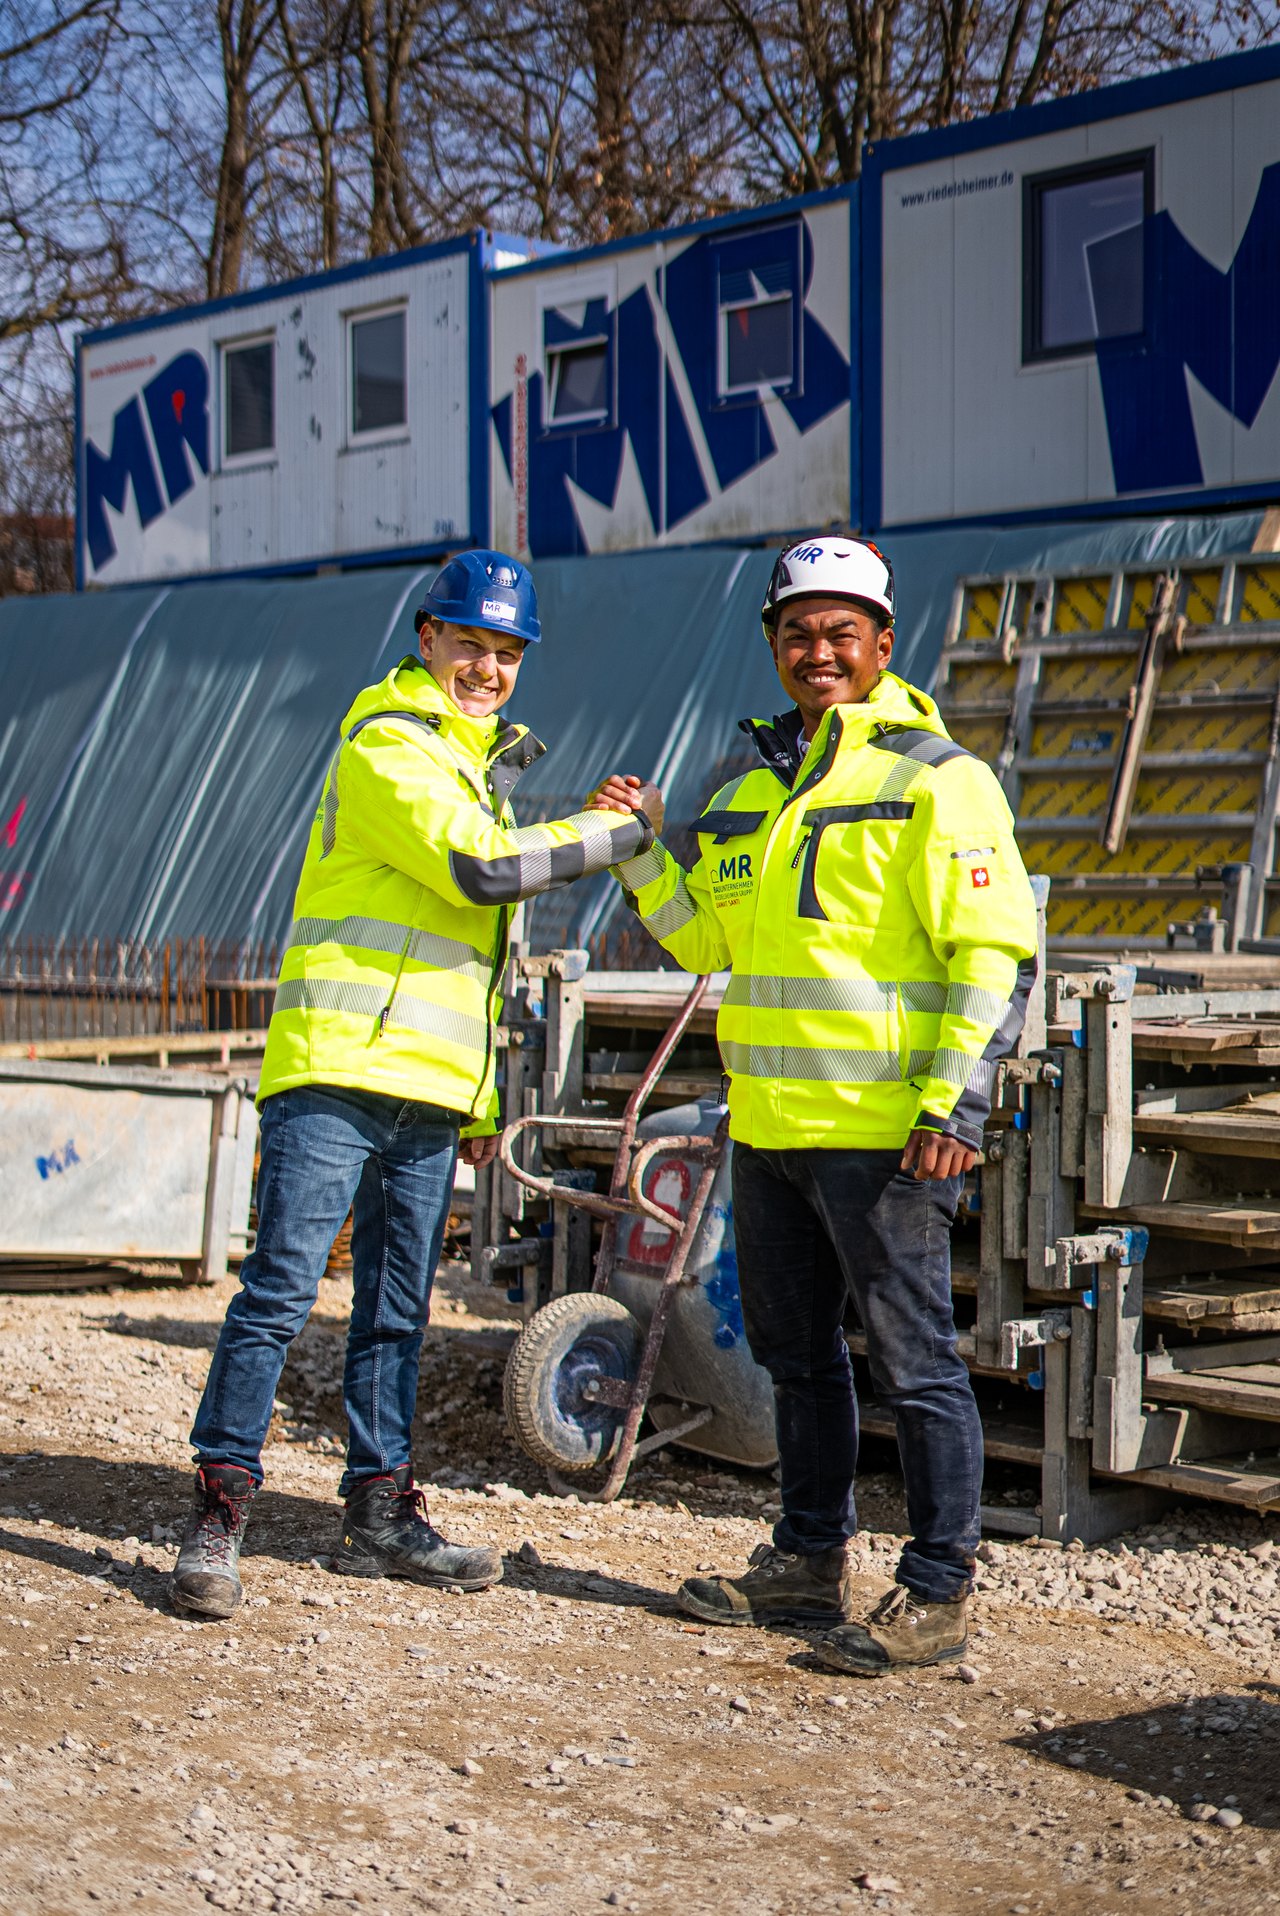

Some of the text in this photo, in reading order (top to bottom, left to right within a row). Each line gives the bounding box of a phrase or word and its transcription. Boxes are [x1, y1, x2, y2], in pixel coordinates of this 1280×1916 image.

[901, 170, 1014, 209] www.riedelsheimer.de
[86, 349, 210, 573] MR
[788, 546, 824, 565] MR
[484, 602, 501, 613] MR
[719, 854, 753, 882] MR
